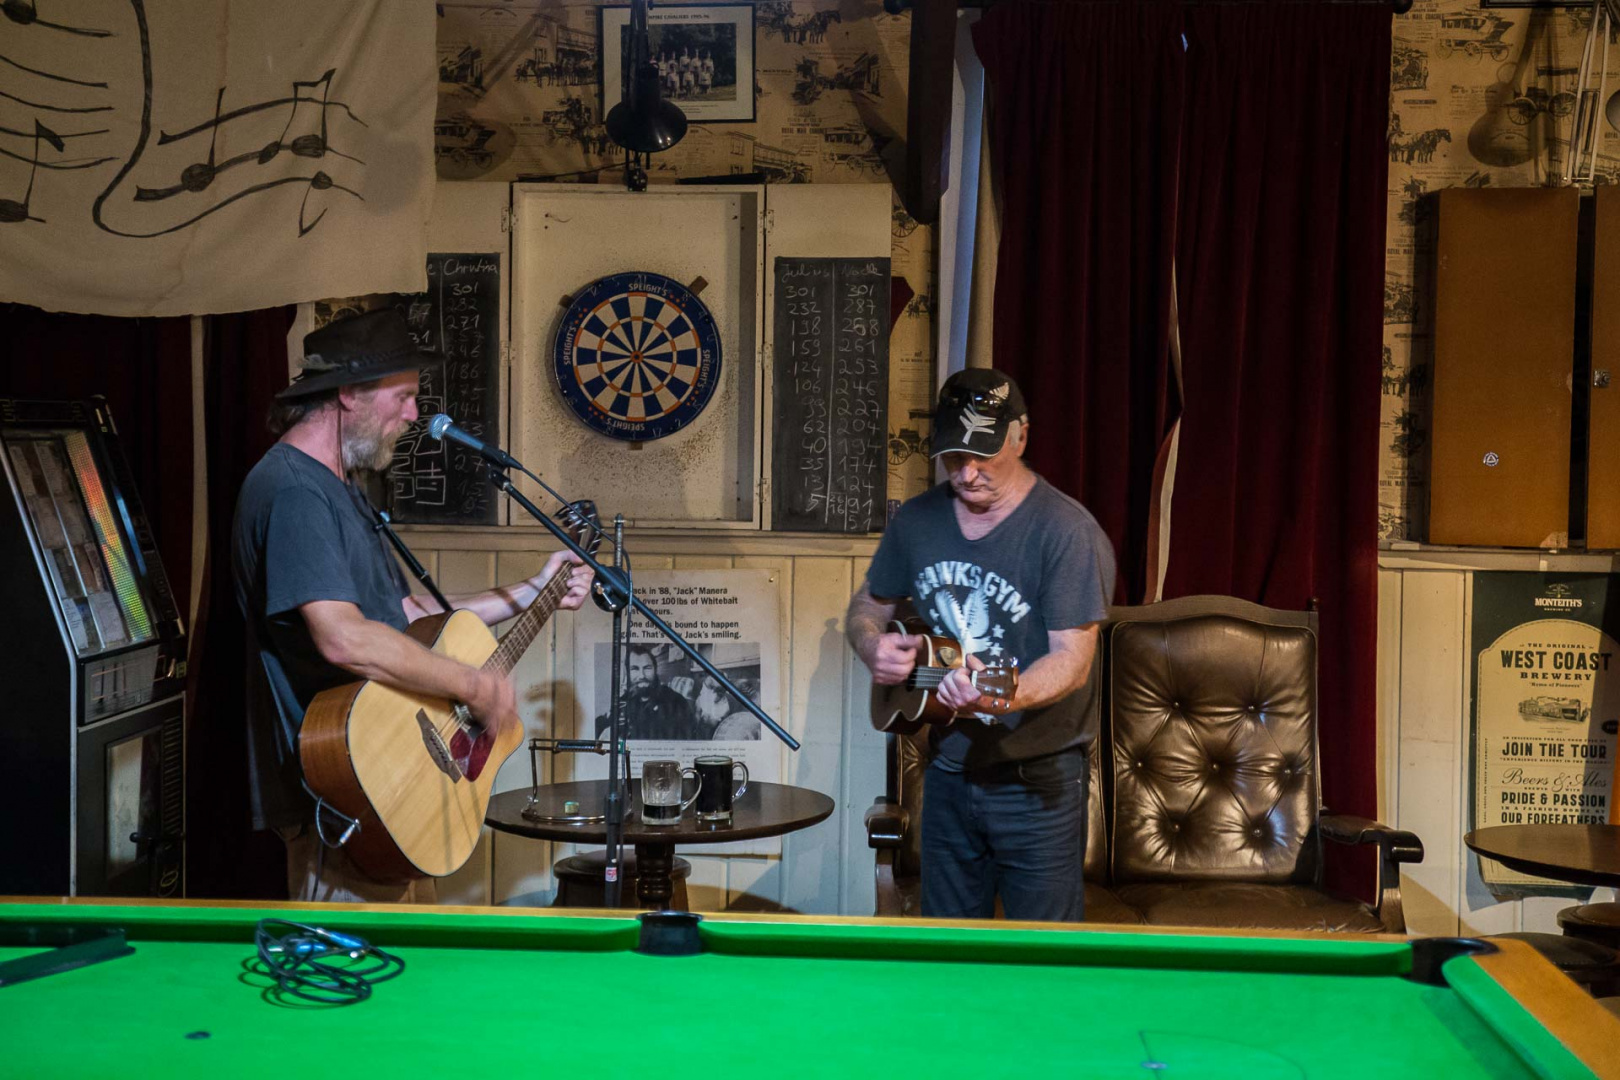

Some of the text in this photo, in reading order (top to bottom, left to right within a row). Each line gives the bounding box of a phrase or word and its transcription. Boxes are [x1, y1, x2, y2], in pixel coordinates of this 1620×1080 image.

[450, 281, 479, 296] 301
[785, 285, 816, 299] 301
[847, 284, 874, 297] 301
[787, 301, 822, 315] 232
[839, 338, 876, 355] 261
[838, 358, 879, 375] 253
[795, 378, 821, 394] 106
[835, 378, 878, 397] 246
[837, 398, 883, 419] 227
[803, 420, 826, 434] 62
[839, 456, 877, 475] 174
[837, 475, 874, 497] 124
[848, 515, 872, 532] 51
[632, 587, 647, 595] ack
[649, 587, 656, 595] in
[698, 587, 728, 595] Manera
[983, 571, 1032, 624] GYM
[661, 597, 676, 605] 100
[691, 597, 699, 605] of
[701, 597, 738, 605] Whitebait
[1534, 598, 1583, 608] MONTEITH'S
[711, 621, 739, 630] happen
[641, 630, 665, 639] That's
[684, 631, 709, 639] Jack's
[711, 631, 742, 641] smiling.
[1501, 650, 1613, 671] WEST COAST
[1520, 672, 1592, 681] BREWERY
[1502, 742, 1607, 759] JOIN THE TOUR
[1502, 767, 1549, 785] Beers
[1569, 770, 1607, 788] Ales
[1501, 791, 1606, 807] PRIDE & PASSION
[1501, 812, 1606, 825] OUR FOREFATHERS
